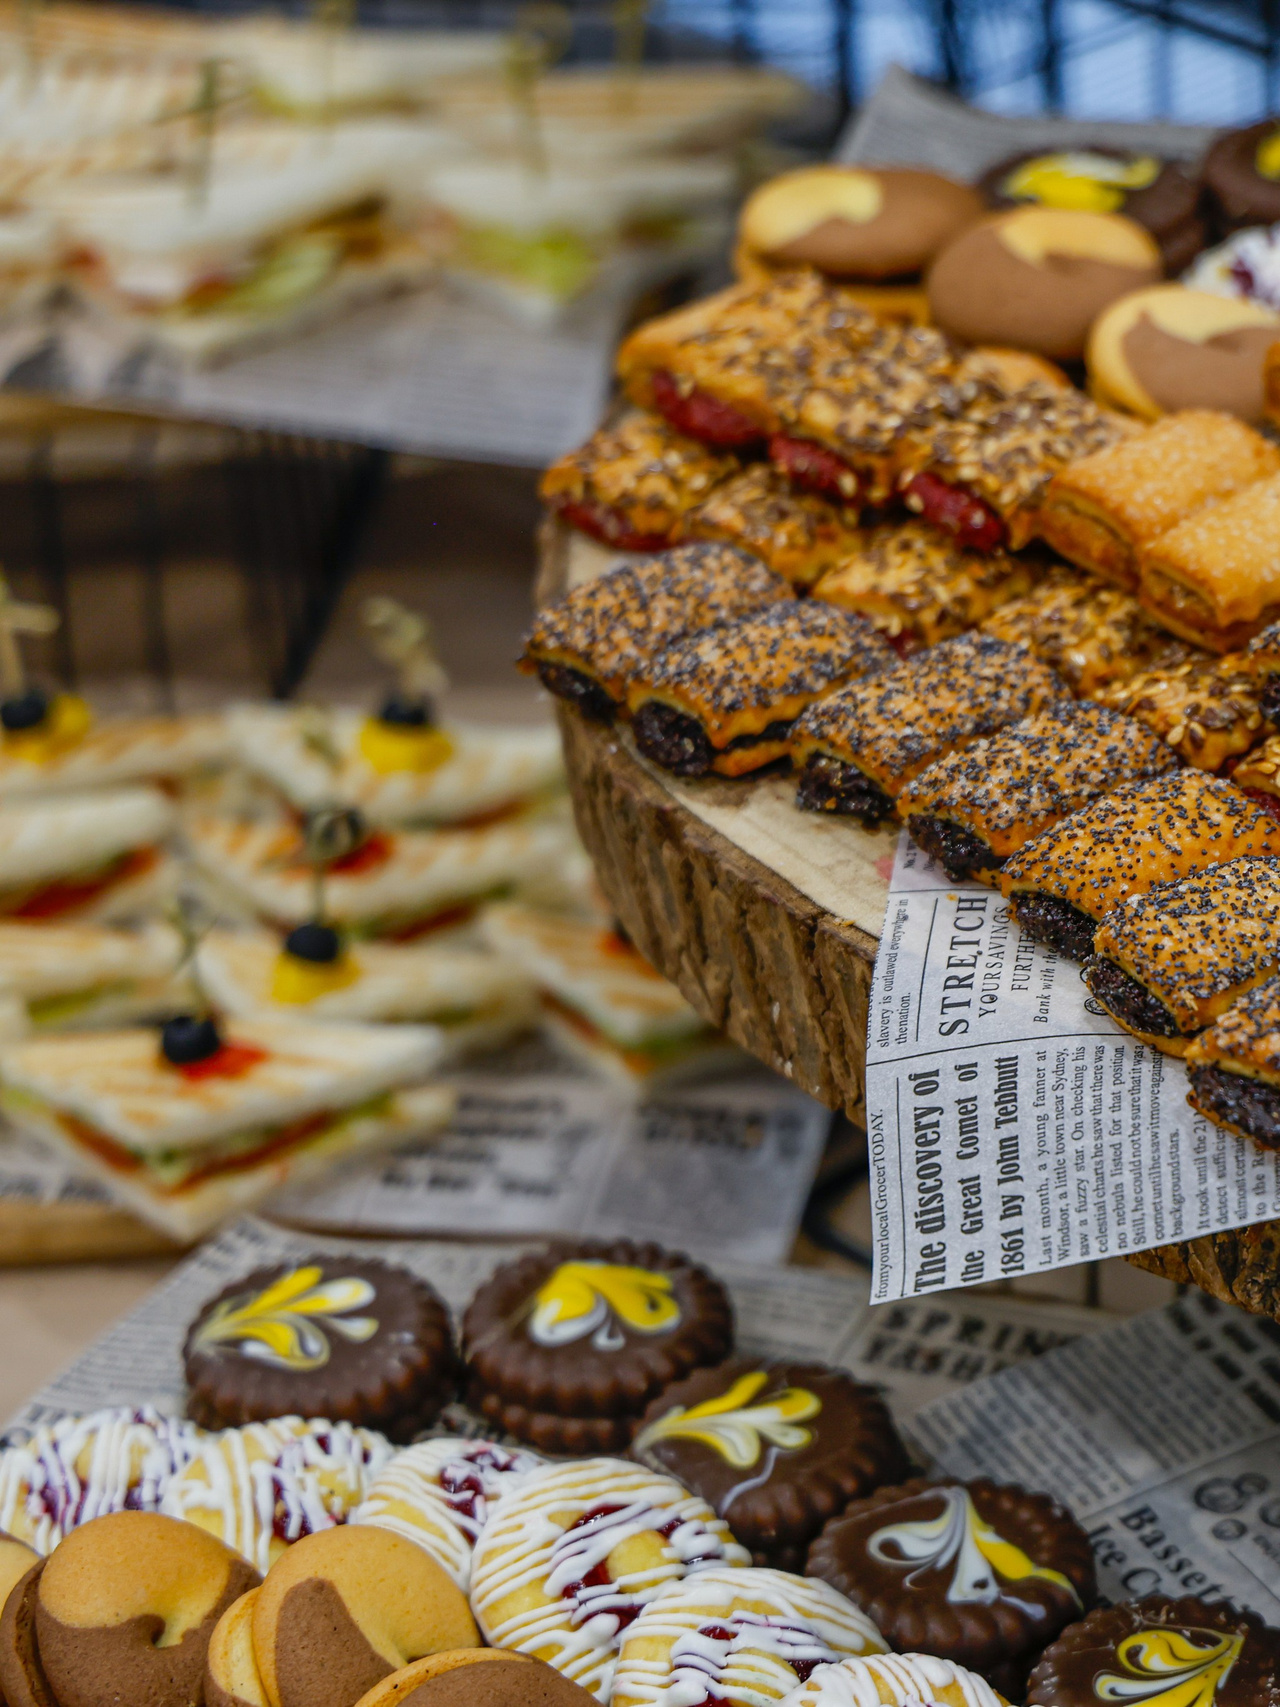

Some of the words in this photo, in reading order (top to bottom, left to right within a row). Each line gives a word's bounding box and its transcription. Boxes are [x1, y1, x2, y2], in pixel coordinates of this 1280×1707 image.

[898, 899, 909, 907] in
[889, 908, 910, 951] everywhere
[938, 896, 989, 1037] STRETCH
[1040, 946, 1061, 964] the
[881, 952, 899, 992] outlawed
[1040, 968, 1056, 991] with
[882, 995, 893, 1005] is
[1032, 993, 1052, 1024] Bank
[876, 1008, 895, 1048] slavery
[1034, 1050, 1047, 1062] at
[1051, 1047, 1070, 1092] Sydney,
[1071, 1046, 1086, 1062] his
[1093, 1045, 1106, 1065] was
[1109, 1044, 1126, 1087] position.
[908, 1068, 940, 1097] of
[953, 1061, 979, 1082] of
[1089, 1064, 1104, 1093] there
[993, 1054, 1019, 1130] Tebbutt
[1070, 1064, 1088, 1117] checking
[1089, 1092, 1103, 1117] that
[1108, 1090, 1122, 1114] that
[1054, 1094, 1065, 1121] near
[954, 1094, 980, 1161] Comet
[1036, 1113, 1051, 1158] young
[1054, 1122, 1066, 1156] town
[1072, 1120, 1085, 1142] On
[1092, 1117, 1104, 1142] saw
[1108, 1118, 1123, 1137] for
[995, 1134, 1024, 1187] John
[1037, 1162, 1048, 1172] a
[1073, 1145, 1086, 1173] star.
[1090, 1142, 1104, 1160] he
[1108, 1141, 1124, 1178] listed
[1212, 1126, 1229, 1180] sufficien
[1232, 1136, 1248, 1177] certain
[913, 1106, 947, 1235] discovery
[1053, 1157, 1068, 1190] little
[1092, 1159, 1106, 1199] charts
[957, 1173, 985, 1235] Great
[999, 1194, 1025, 1222] by
[1035, 1177, 1052, 1229] month,
[1058, 1190, 1069, 1201] a
[1074, 1178, 1090, 1214] fuzzy
[1111, 1182, 1126, 1227] nebula
[1057, 1202, 1071, 1262] Windsor,
[1078, 1218, 1089, 1227] a
[1092, 1200, 1109, 1254] celestial
[1000, 1226, 1025, 1275] 1861
[1038, 1235, 1053, 1266] Last
[1079, 1232, 1091, 1257] saw
[1117, 1232, 1128, 1250] no
[913, 1241, 950, 1293] The
[960, 1249, 988, 1284] the
